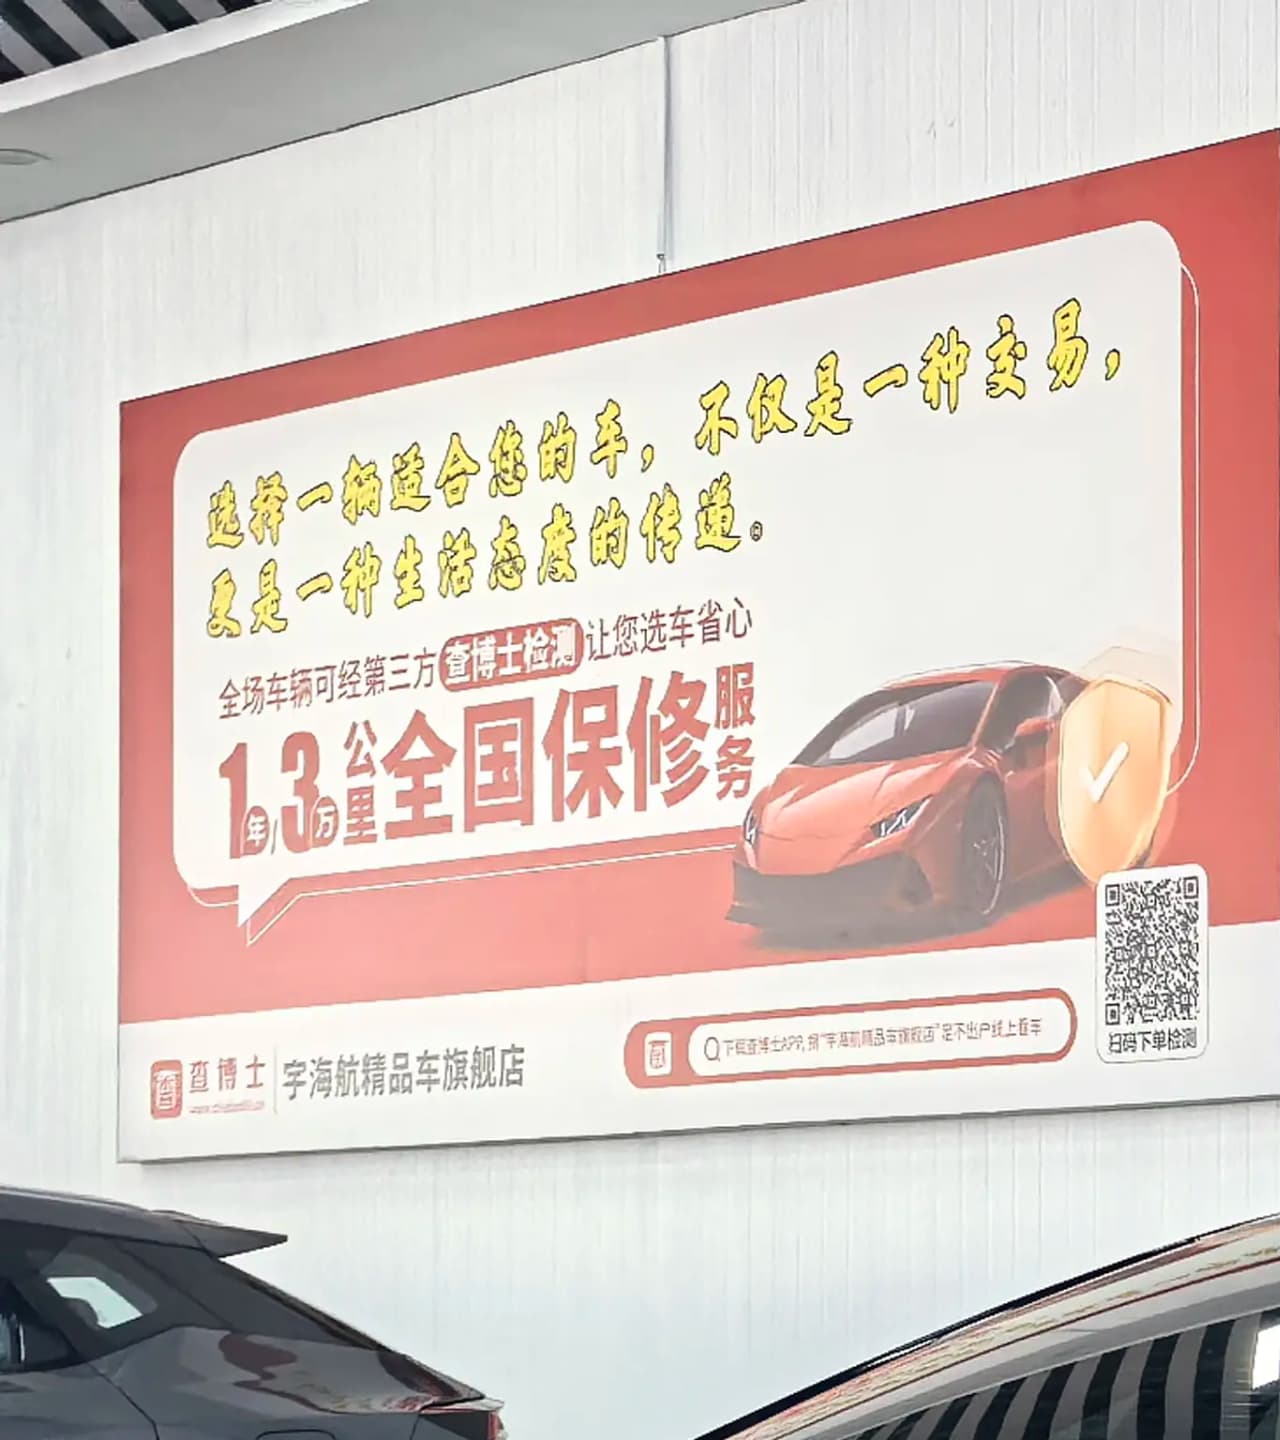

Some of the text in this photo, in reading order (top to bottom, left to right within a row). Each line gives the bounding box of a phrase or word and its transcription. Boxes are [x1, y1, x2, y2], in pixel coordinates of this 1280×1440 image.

[282, 1043, 525, 1100] 宇海航精品车旗舰店
